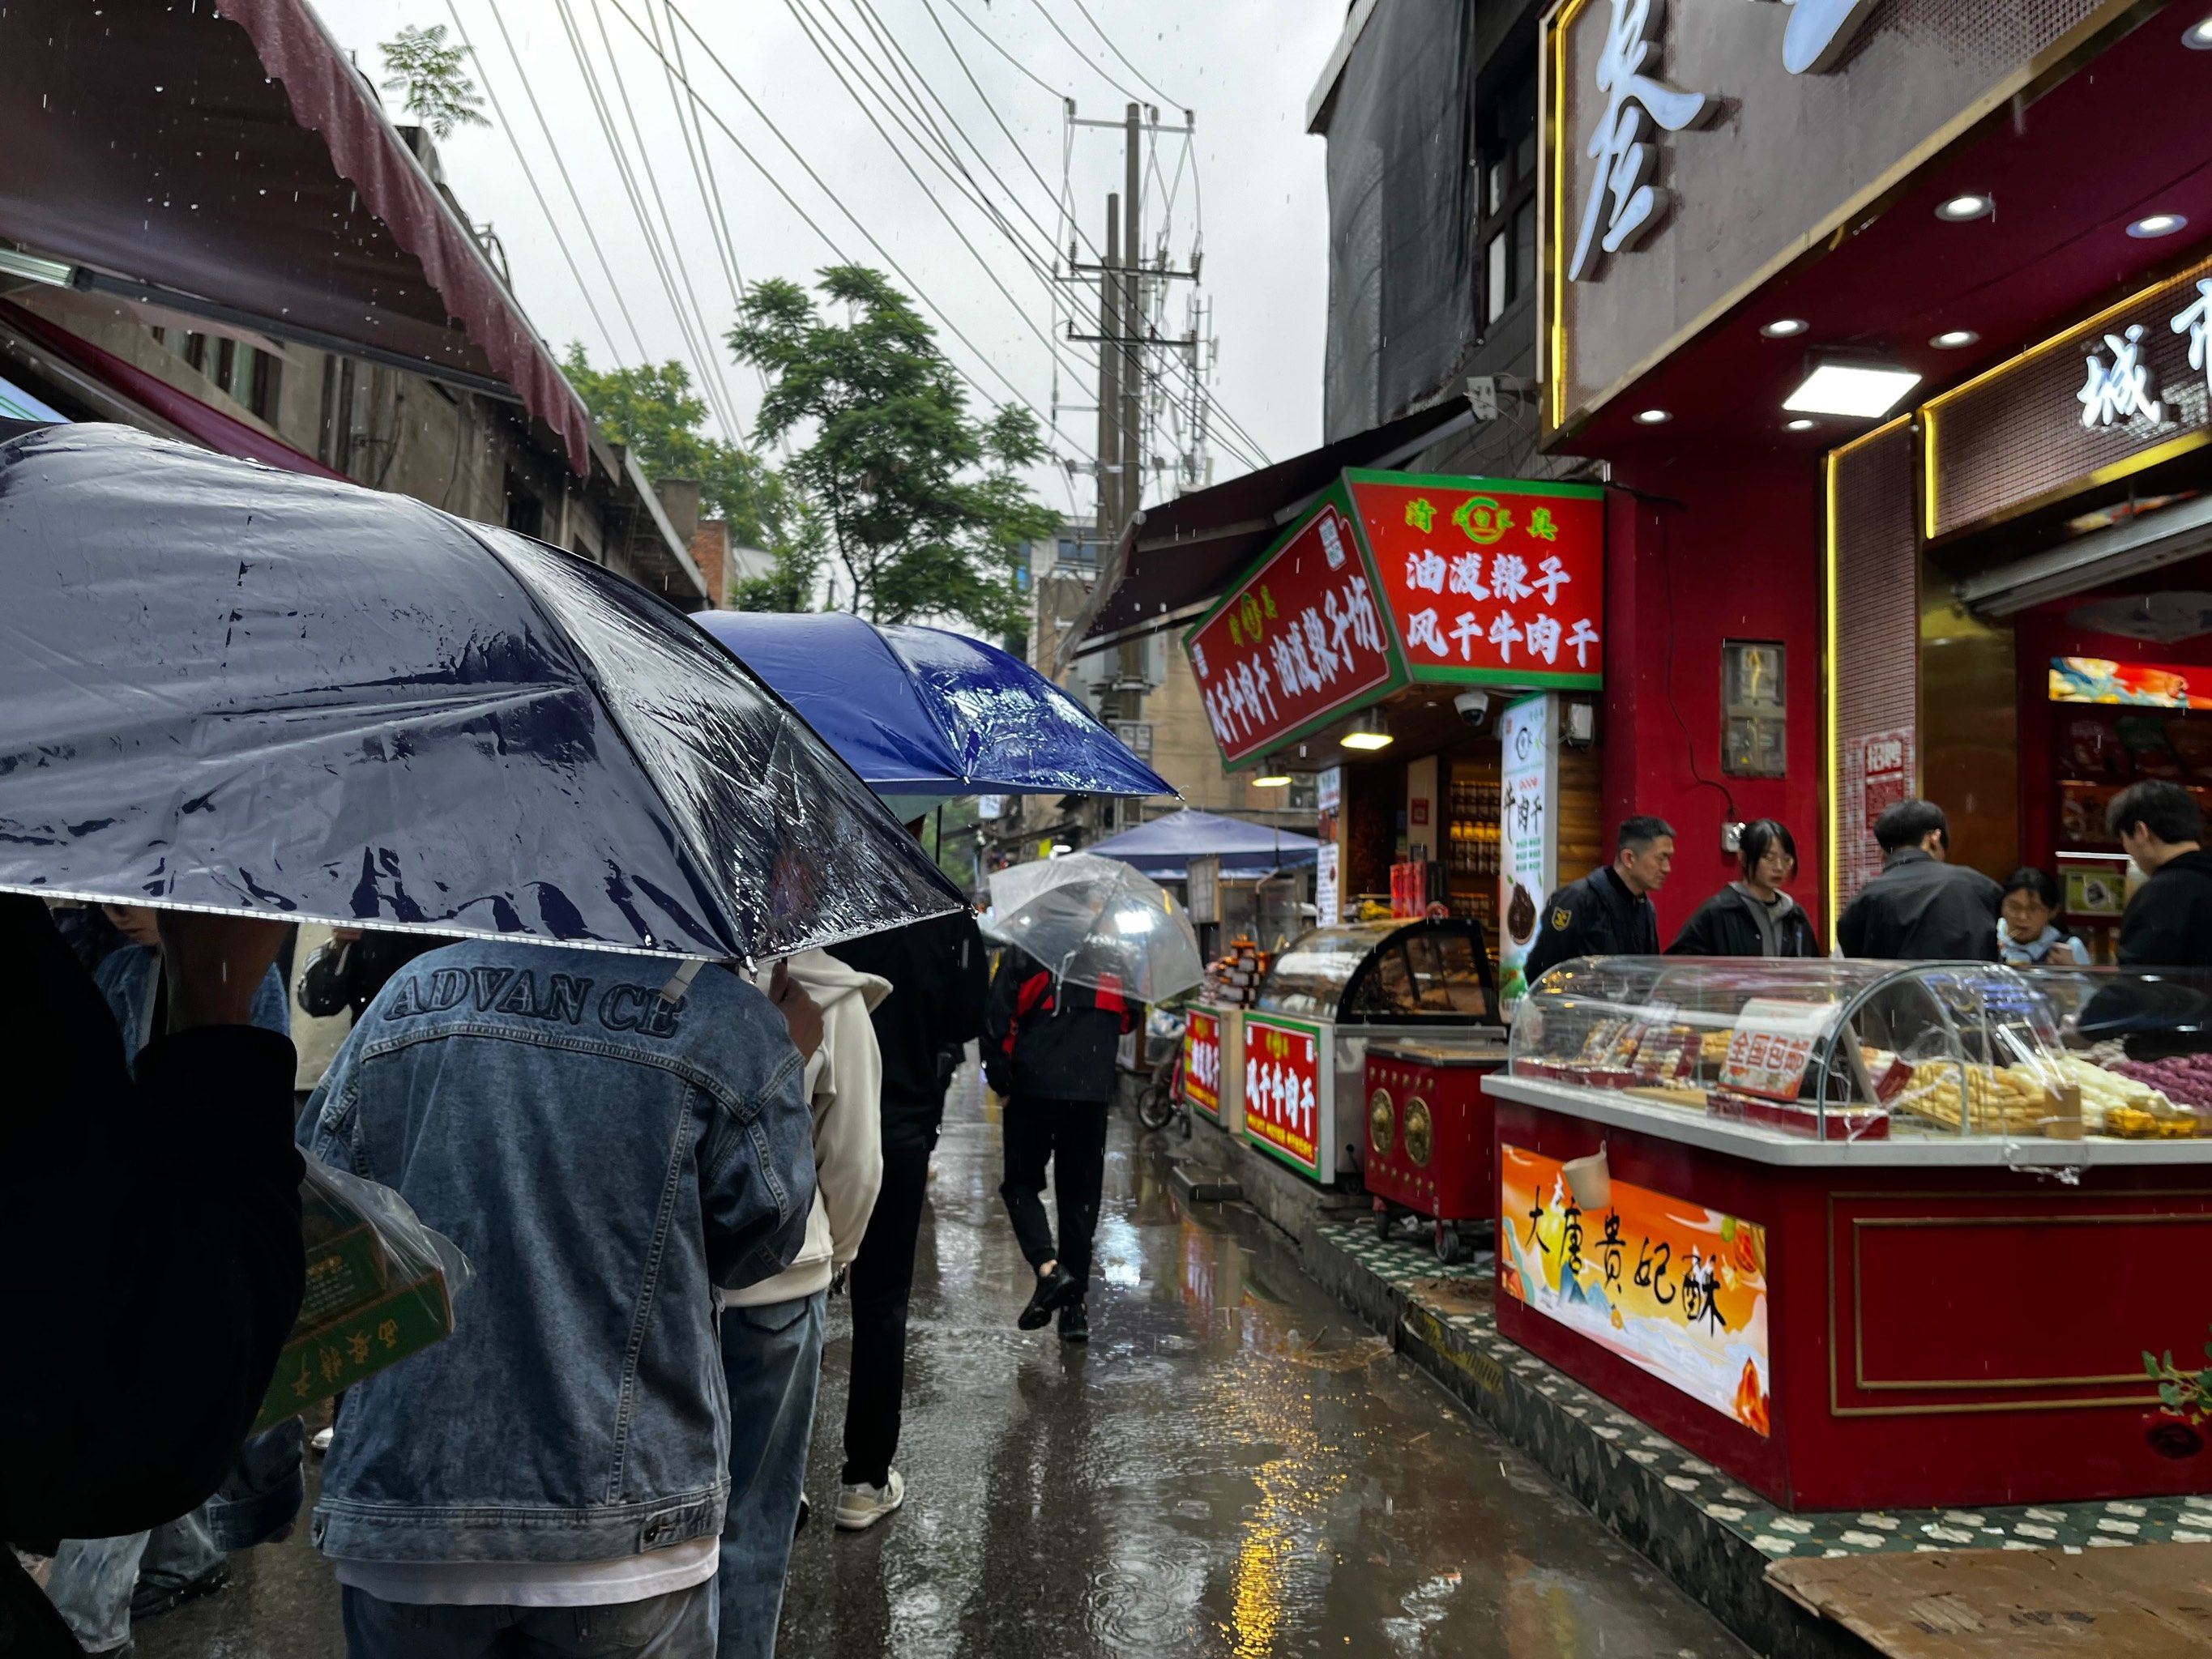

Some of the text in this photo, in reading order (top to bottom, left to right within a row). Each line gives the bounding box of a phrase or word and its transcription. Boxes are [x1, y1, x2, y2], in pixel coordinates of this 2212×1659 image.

[1404, 497, 1437, 534] 清
[1526, 506, 1558, 541] 真
[1404, 548, 1571, 606] 油泼辣子
[1407, 607, 1600, 668] 风干牛肉干
